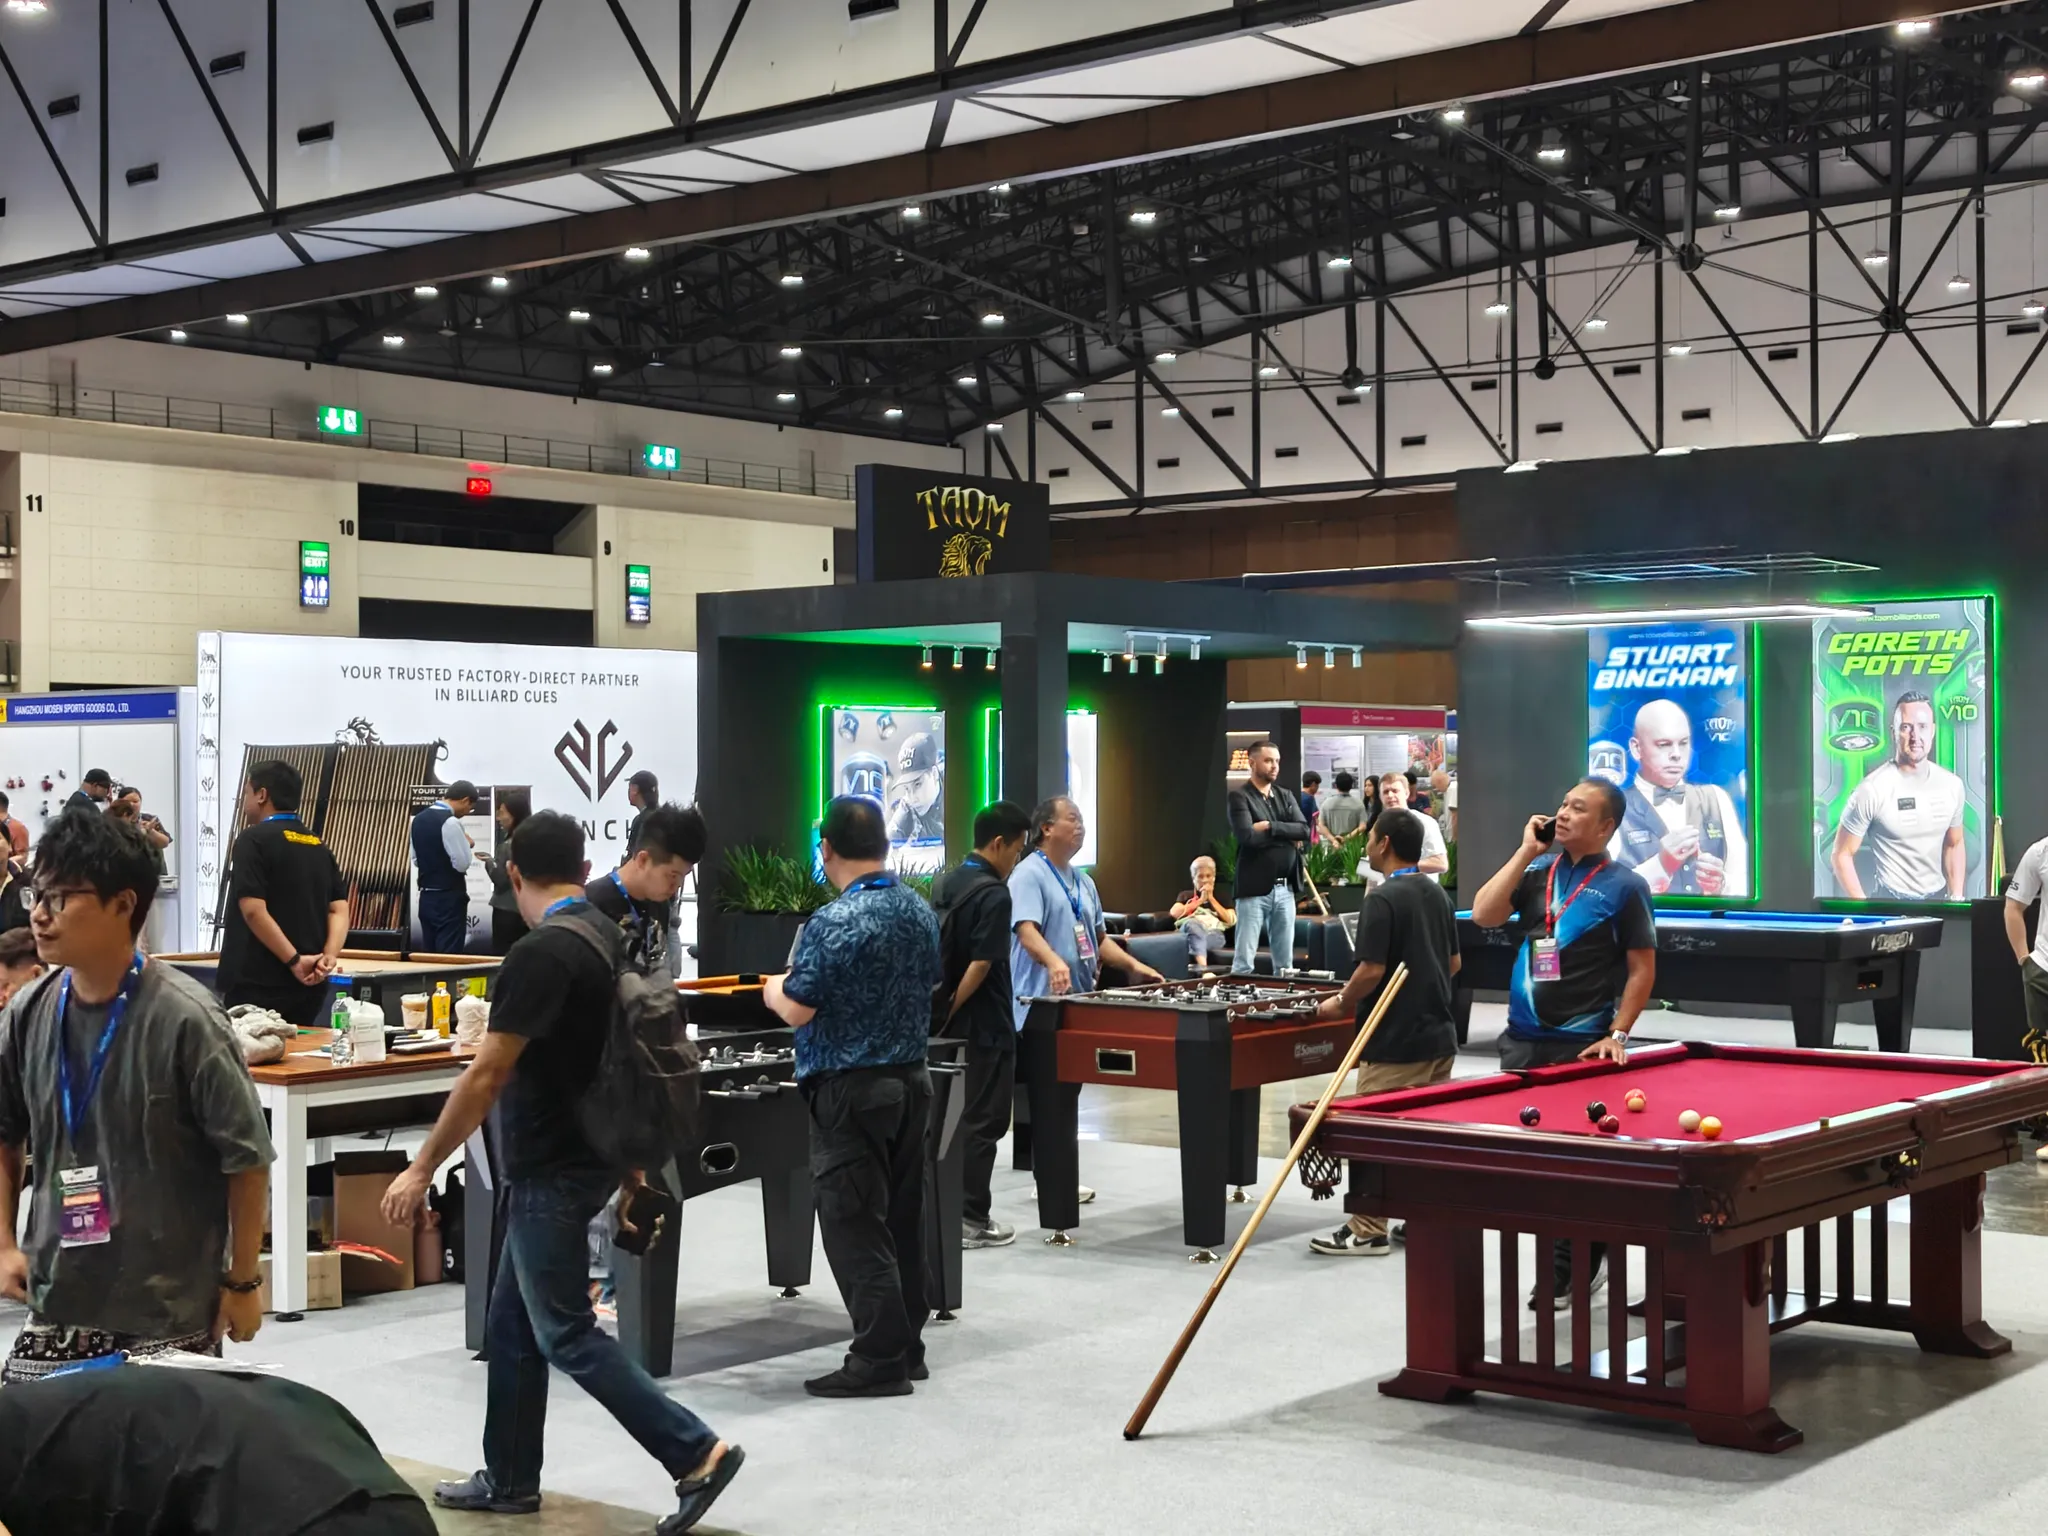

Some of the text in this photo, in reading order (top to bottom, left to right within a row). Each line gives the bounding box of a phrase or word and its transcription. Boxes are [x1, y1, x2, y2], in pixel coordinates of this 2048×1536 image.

[26, 494, 42, 512] 11
[916, 485, 1012, 538] TAOM
[339, 519, 354, 536] 10
[604, 540, 611, 555] 9
[304, 556, 328, 568] EXIT
[303, 597, 328, 605] TOILET
[1827, 629, 1970, 654] GARETH
[1606, 643, 1733, 668] STUART
[1841, 653, 1956, 676] POTTS
[340, 665, 639, 686] YOUR TRUSTED FACTORY-DIRECT PARTNER
[1593, 665, 1738, 690] BINGHAM
[435, 688, 558, 703] IN BILLIARD CUES
[14, 705, 44, 716] HANGZHOU
[44, 704, 63, 714] MOSEN
[64, 703, 85, 714] SPORTS
[86, 703, 106, 713] GOODS
[118, 703, 131, 713] LTD.
[1940, 704, 1978, 721] V10
